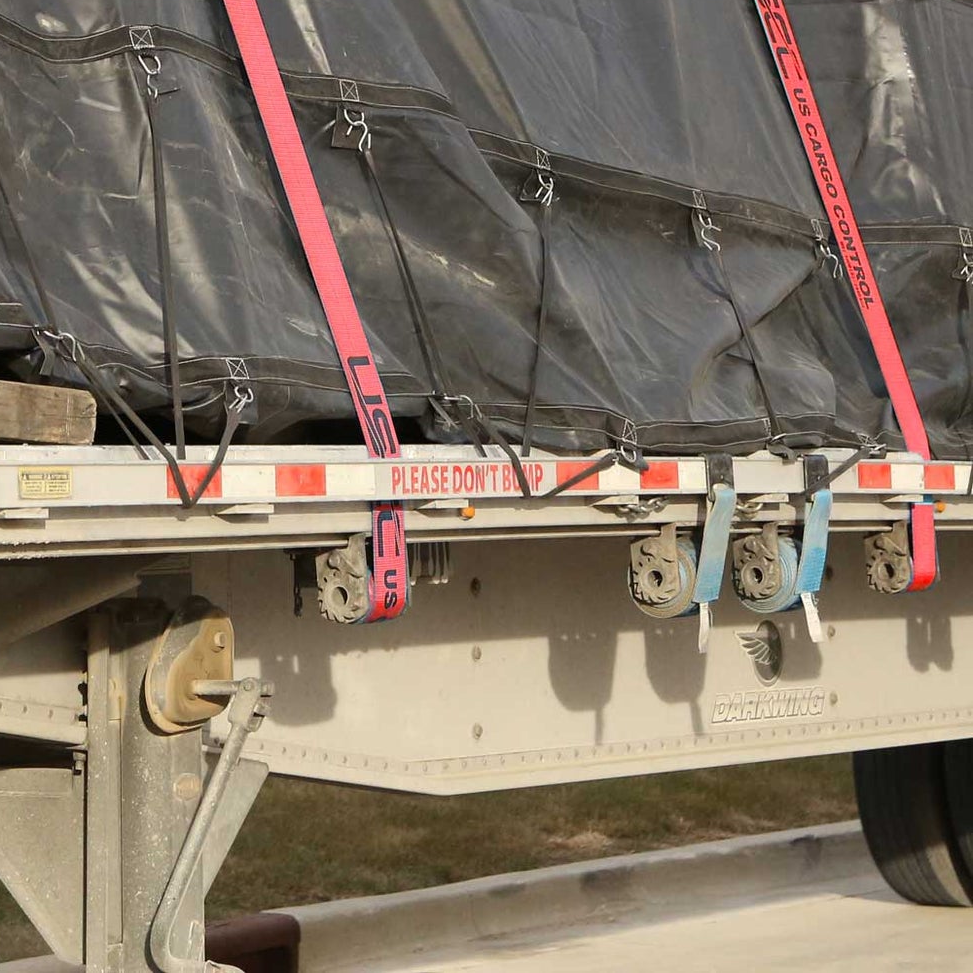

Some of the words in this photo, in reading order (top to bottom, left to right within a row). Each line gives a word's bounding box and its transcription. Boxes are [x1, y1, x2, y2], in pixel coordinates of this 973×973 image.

[793, 87, 811, 117] US
[805, 122, 838, 199] CARGO
[833, 204, 874, 309] CONTROL
[391, 465, 448, 495] PLEASE
[452, 464, 499, 494] DON'T
[383, 569, 398, 609] US
[711, 687, 826, 724] DARKWING
